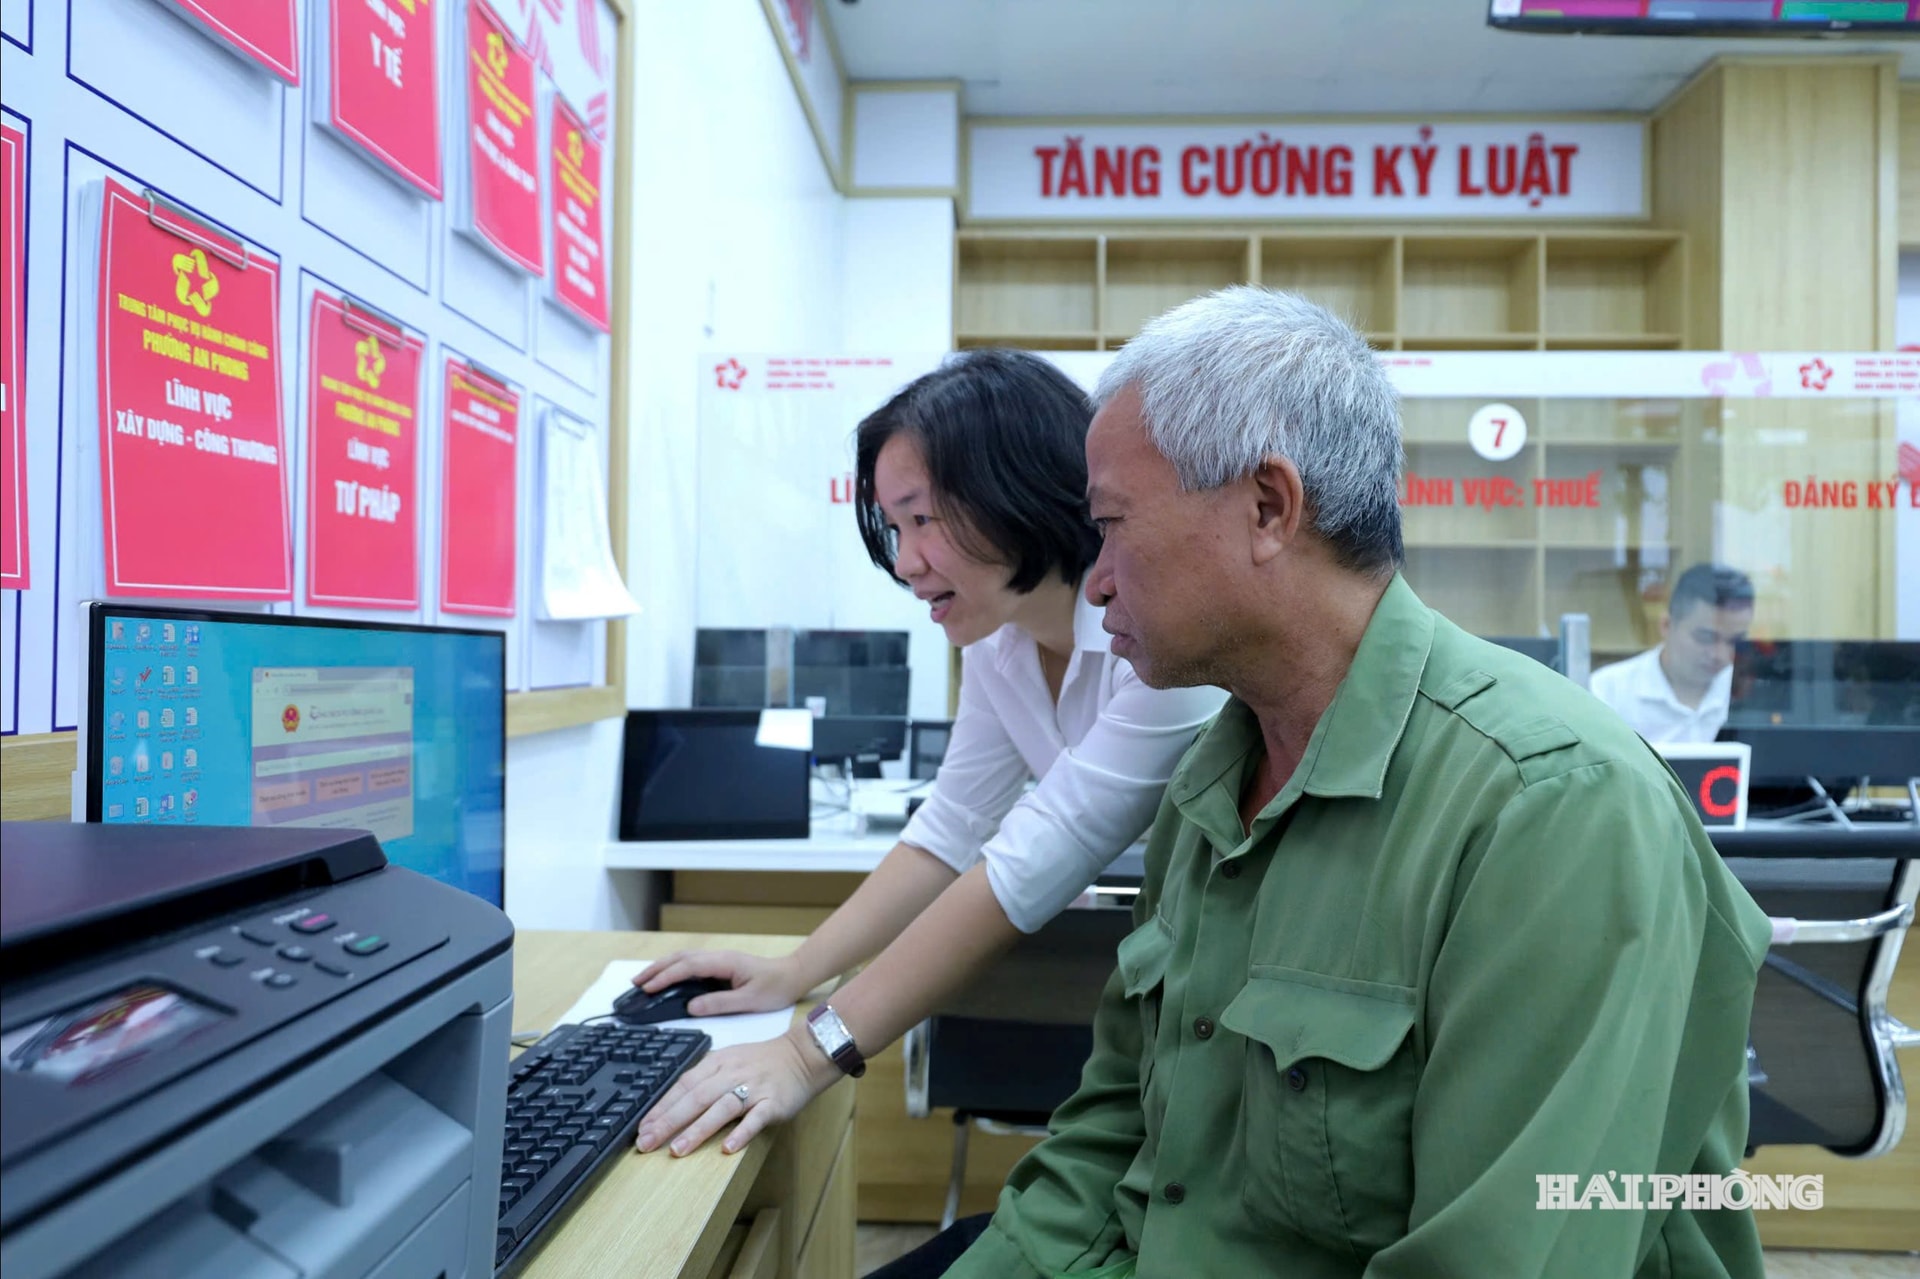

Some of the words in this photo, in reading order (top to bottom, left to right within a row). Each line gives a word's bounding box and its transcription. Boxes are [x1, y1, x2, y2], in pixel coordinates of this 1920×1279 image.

[1033, 135, 1161, 198] TĂNG
[1179, 131, 1354, 198] CƯỜNG
[1373, 124, 1438, 197] KỶ
[1458, 131, 1579, 208] LUẬT
[166, 377, 201, 412] LĨNH
[203, 390, 232, 422] VỰC
[116, 409, 144, 437] XÂY
[147, 417, 185, 446] DỰNG
[195, 427, 230, 455] CÔNG
[1490, 418, 1508, 448] 7
[334, 479, 358, 516] TƯ
[358, 484, 401, 523] PHÁP
[830, 472, 852, 504] LĨ
[1462, 476, 1524, 513] VỰC:
[1531, 468, 1604, 508] THUẾ
[1784, 474, 1858, 508] ĐĂNG
[1867, 473, 1898, 508] KÝ
